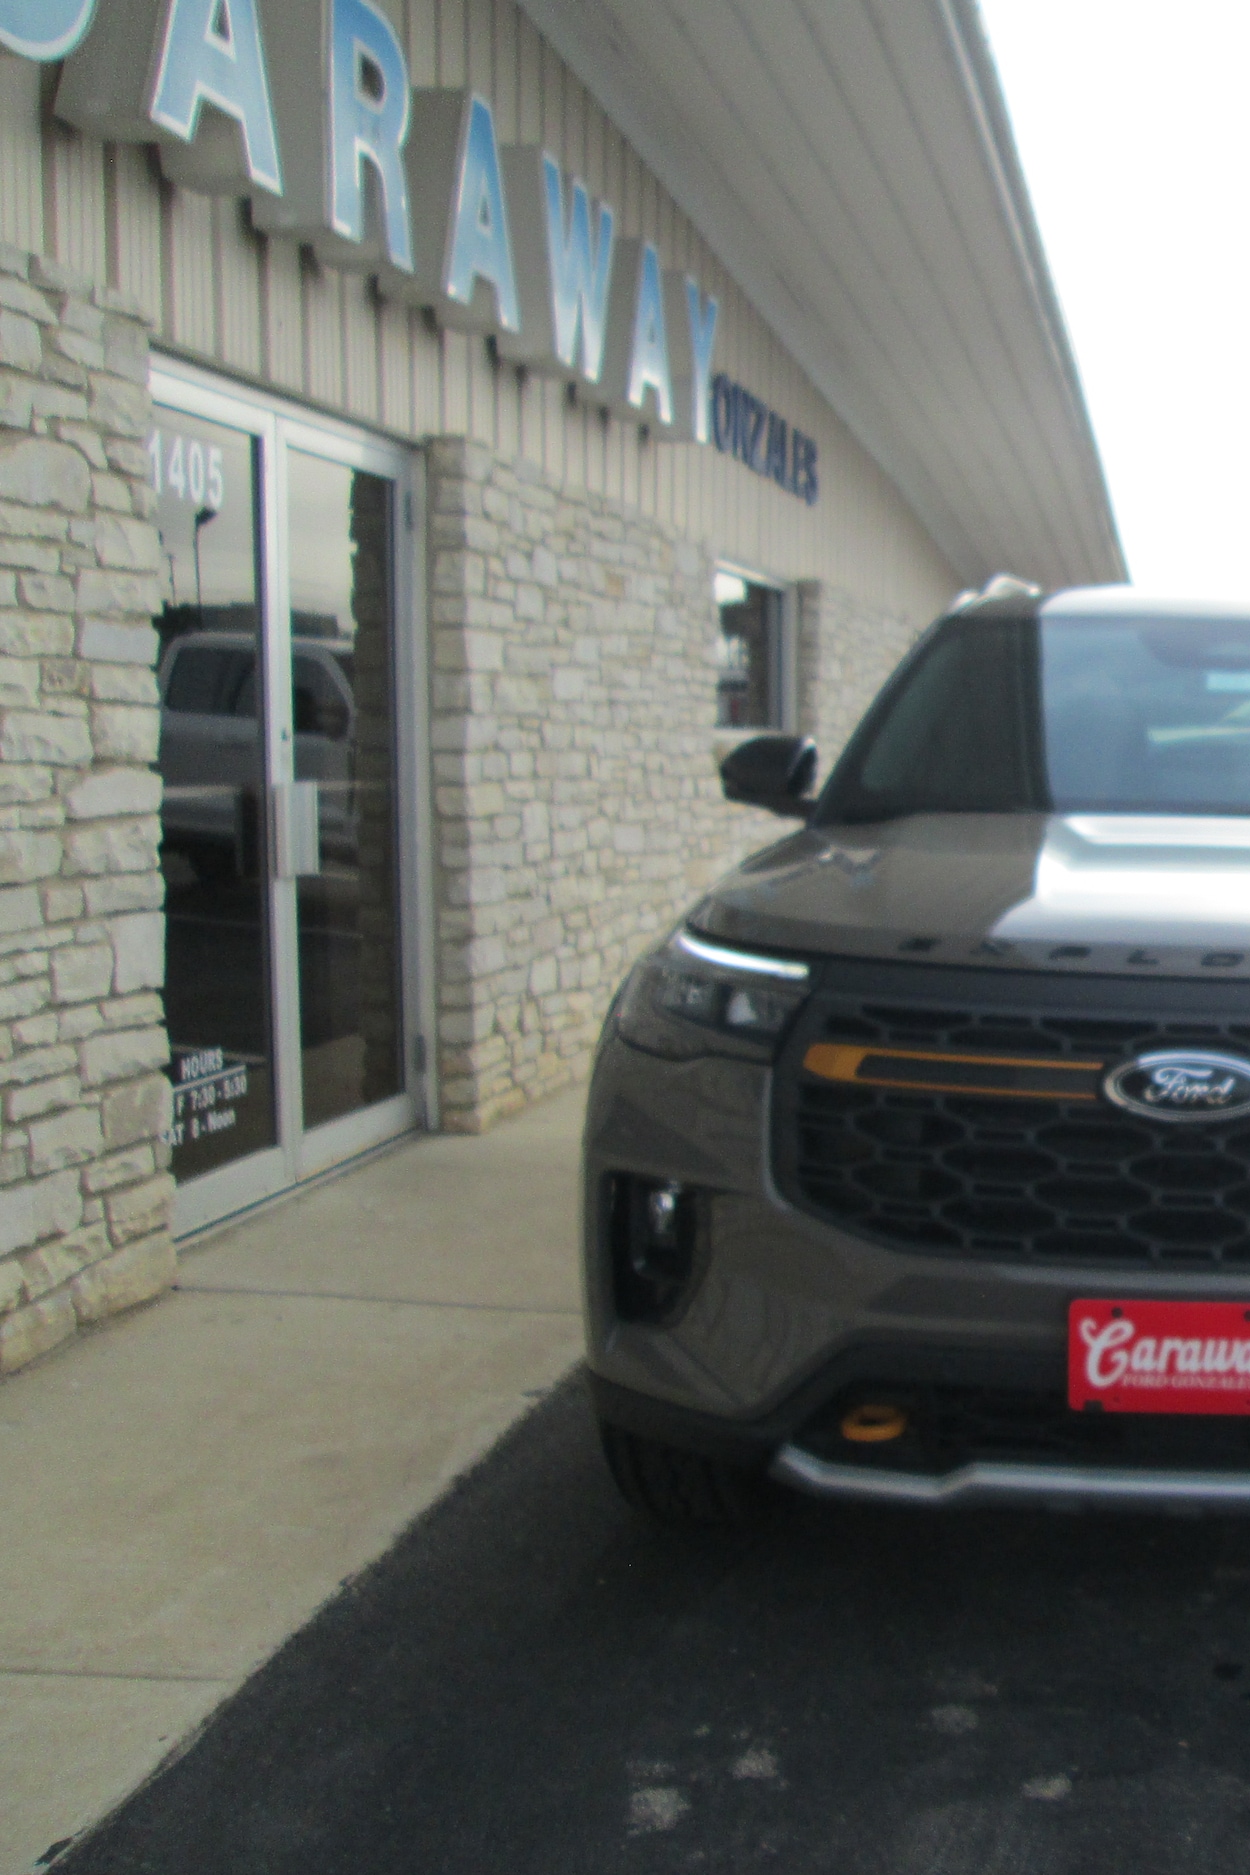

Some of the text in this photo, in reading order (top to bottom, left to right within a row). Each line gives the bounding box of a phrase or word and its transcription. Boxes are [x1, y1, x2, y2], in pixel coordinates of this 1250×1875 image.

[712, 373, 819, 506] ONZALES
[147, 430, 223, 509] 1405
[180, 1048, 223, 1081] HOURS
[1143, 1066, 1236, 1104] Ford
